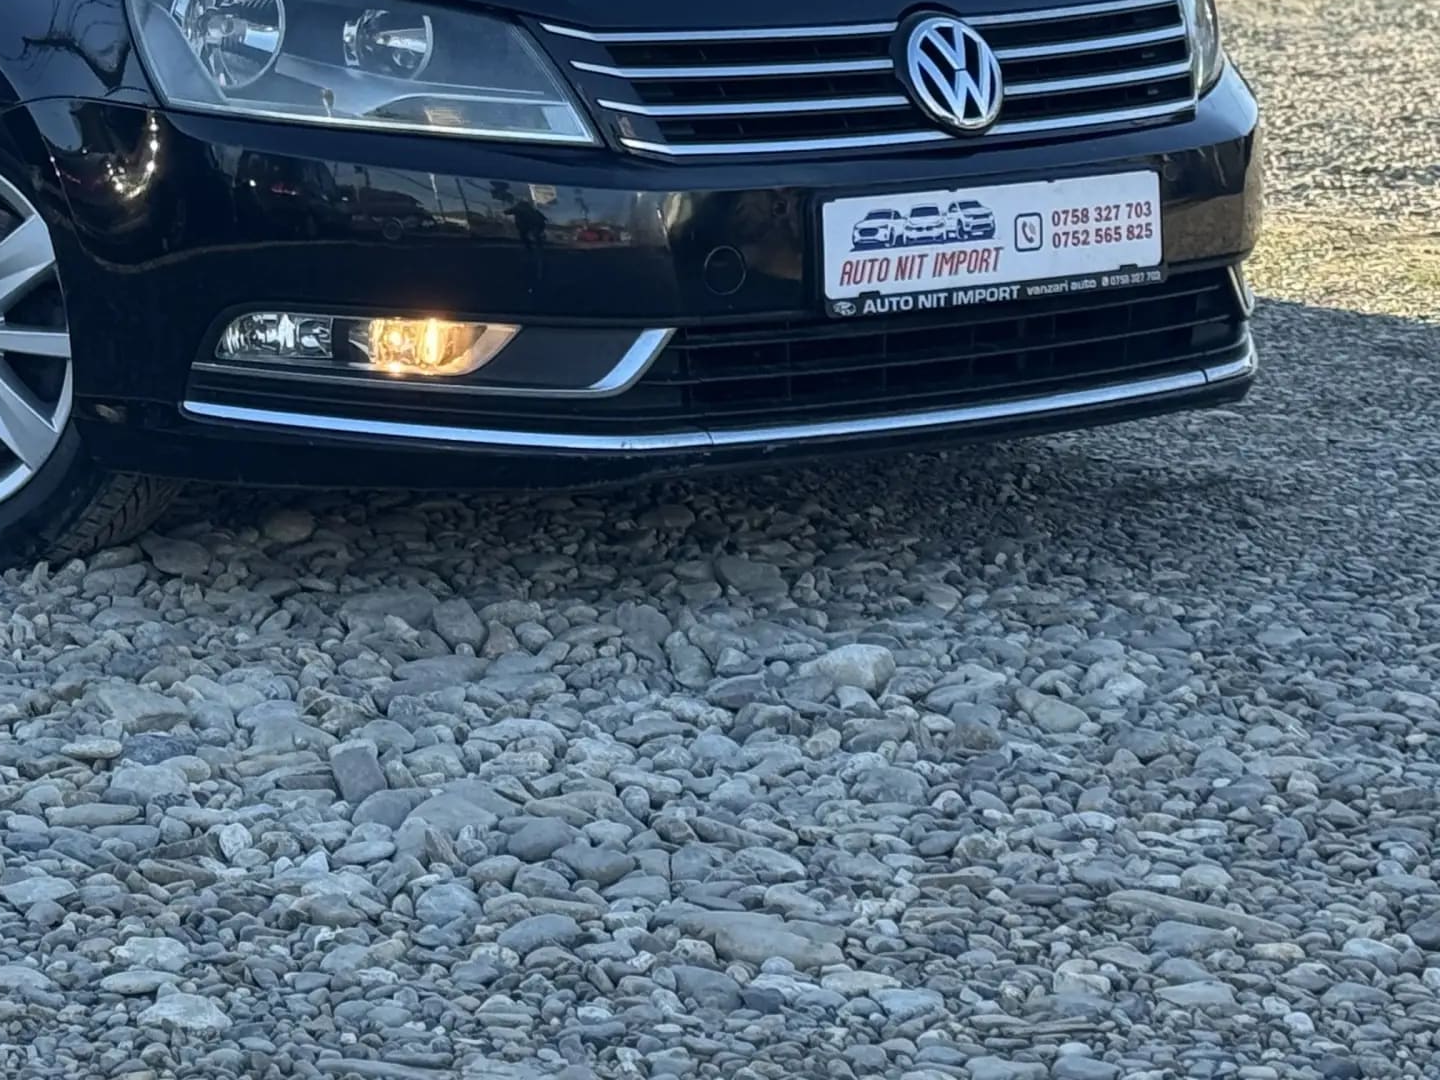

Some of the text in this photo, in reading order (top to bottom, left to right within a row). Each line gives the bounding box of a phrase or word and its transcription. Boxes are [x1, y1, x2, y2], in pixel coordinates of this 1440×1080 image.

[1051, 201, 1153, 227] 0758 327 703
[1052, 222, 1153, 249] 0752 565 825
[839, 246, 1005, 287] AUTO NIT IMPORT
[862, 295, 914, 315] AUTO
[918, 292, 949, 310] NIT
[952, 283, 1021, 306] IMPORT
[1070, 278, 1097, 291] auto
